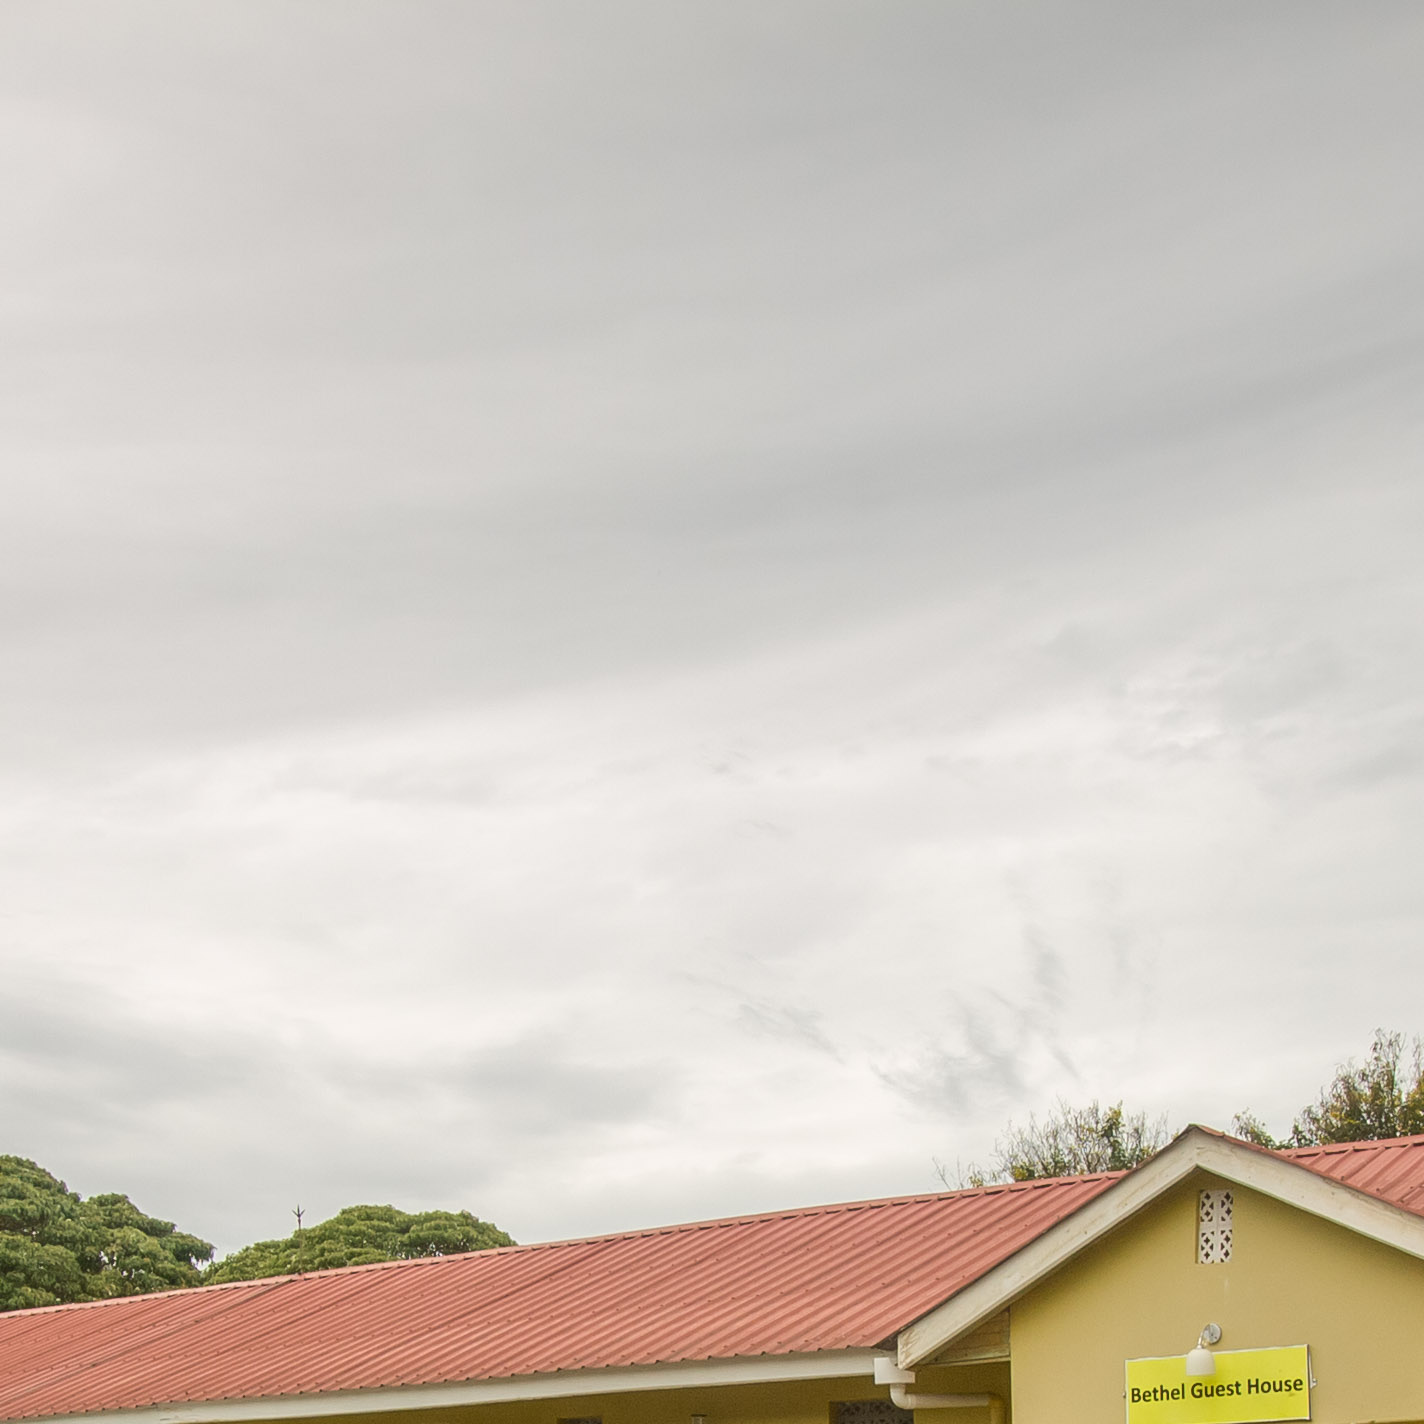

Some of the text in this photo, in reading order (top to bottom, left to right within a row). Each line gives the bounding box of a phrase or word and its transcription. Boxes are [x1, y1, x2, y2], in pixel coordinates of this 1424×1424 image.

[1131, 1377, 1304, 1404] Bethel Guest House
